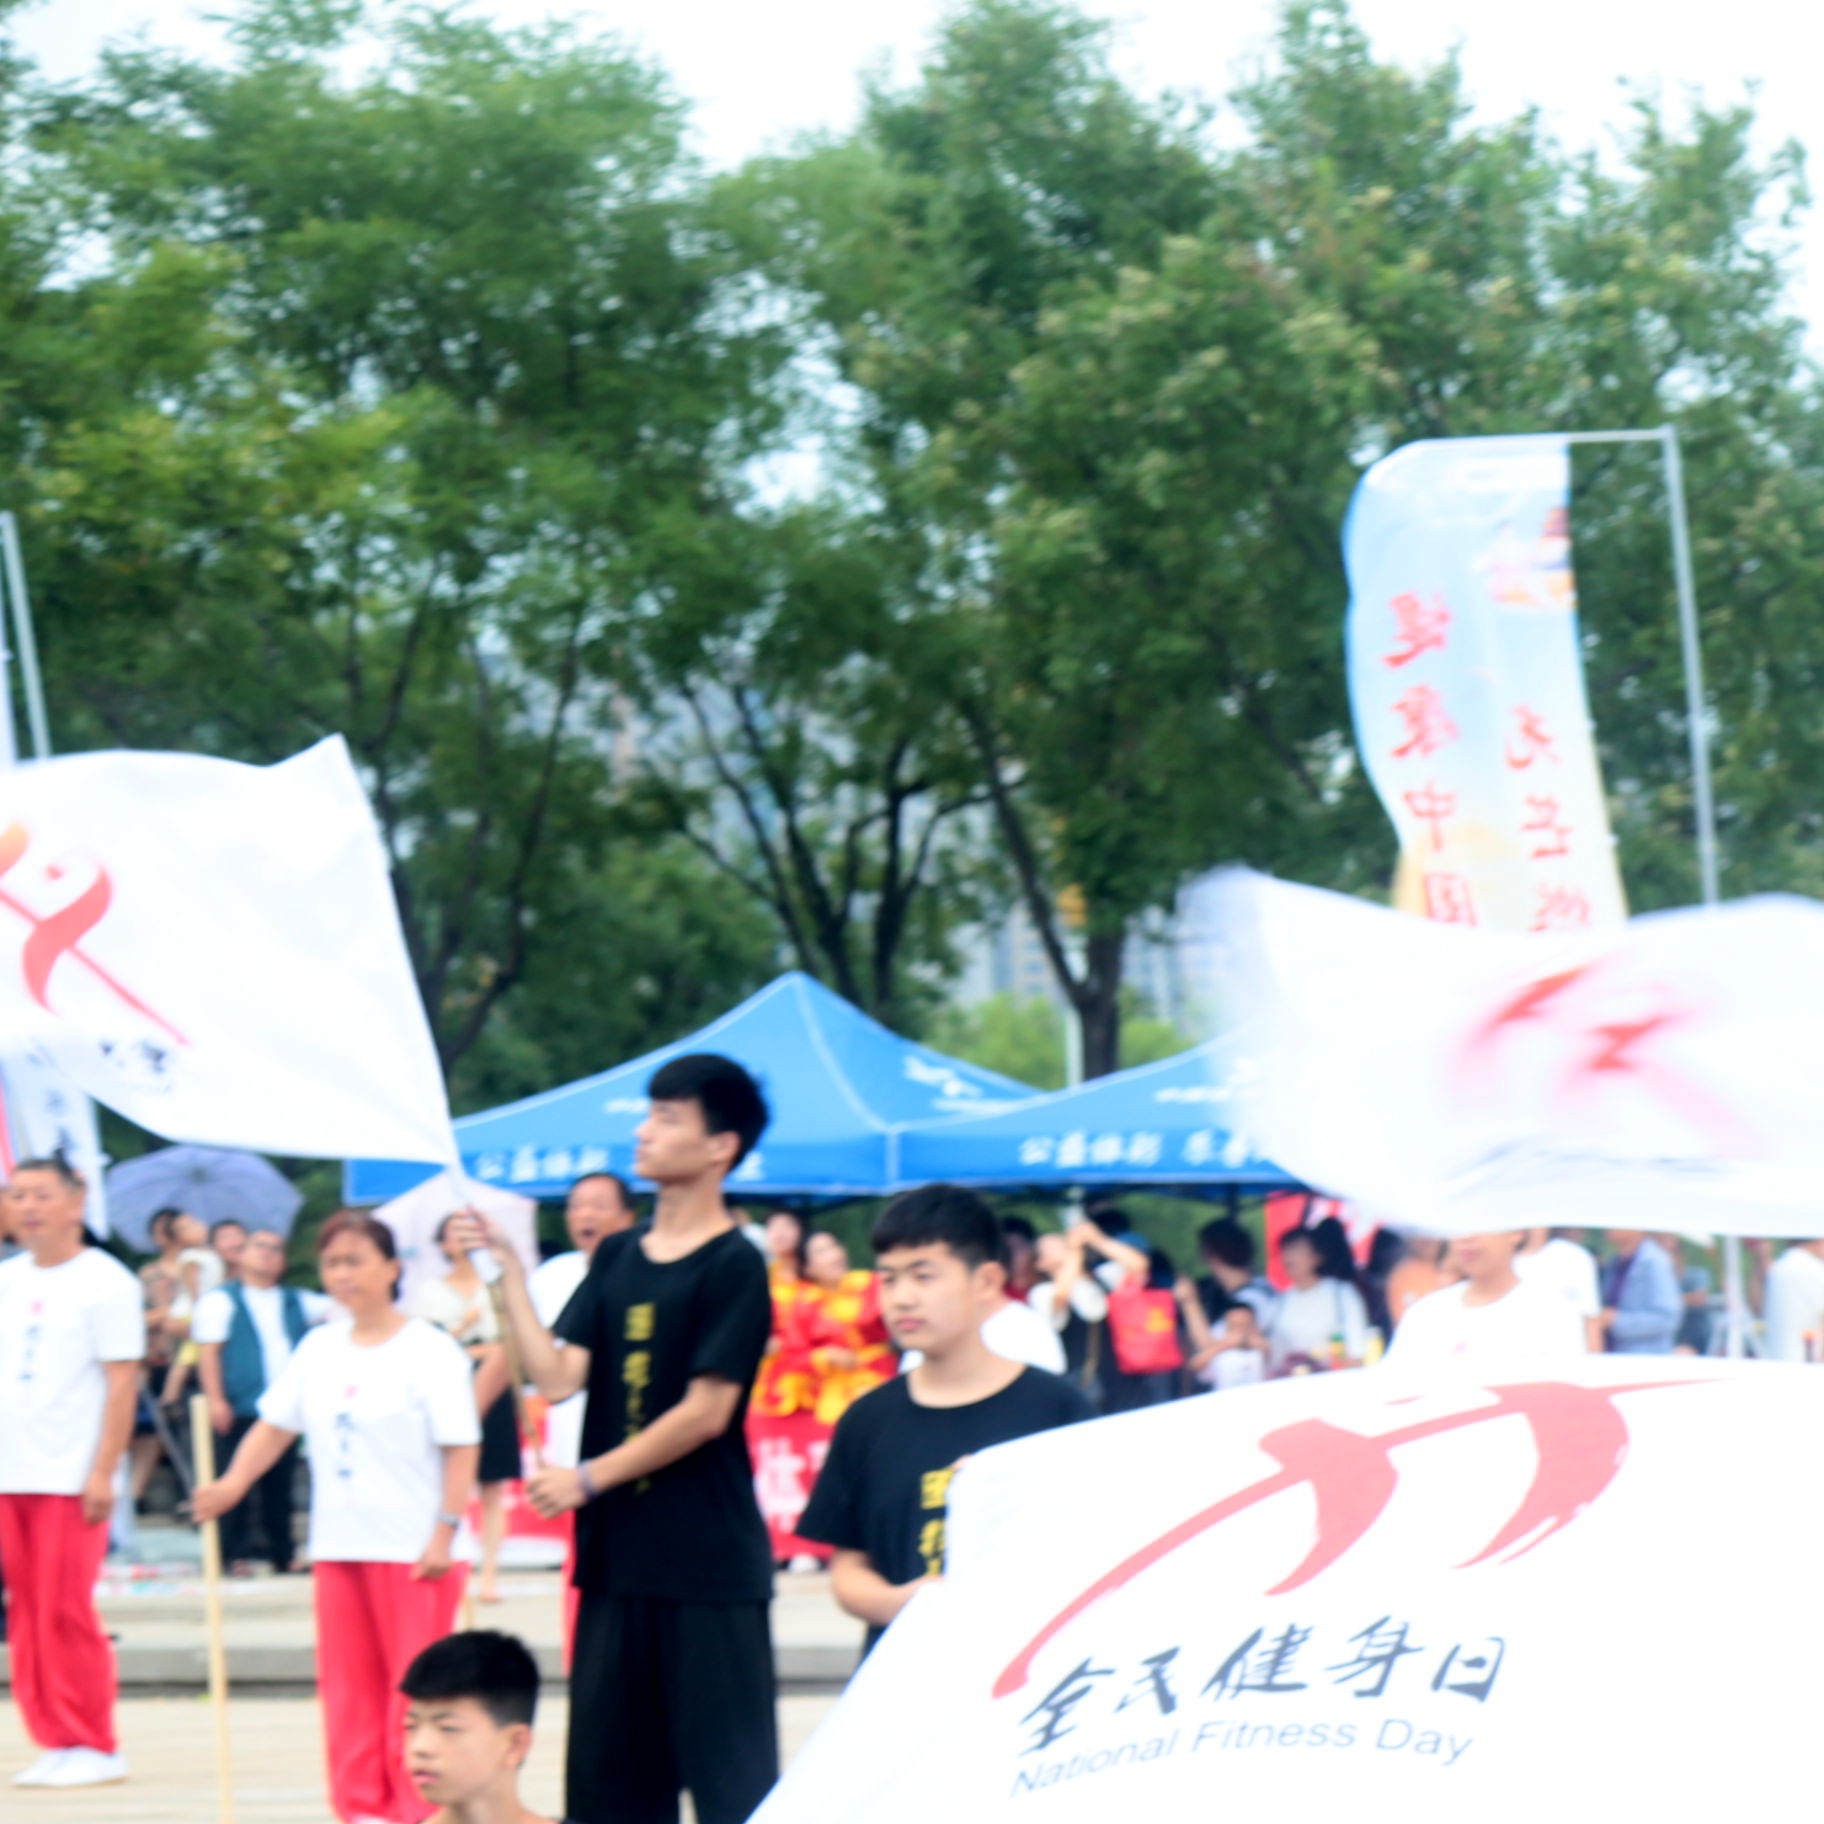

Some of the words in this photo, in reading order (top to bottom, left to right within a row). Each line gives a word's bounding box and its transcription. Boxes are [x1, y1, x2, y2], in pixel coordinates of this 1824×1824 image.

[1016, 1614, 1508, 1760] 全民健身日
[1009, 1730, 1178, 1799] National
[1191, 1718, 1357, 1752] Fitness
[1375, 1717, 1474, 1767] Day
